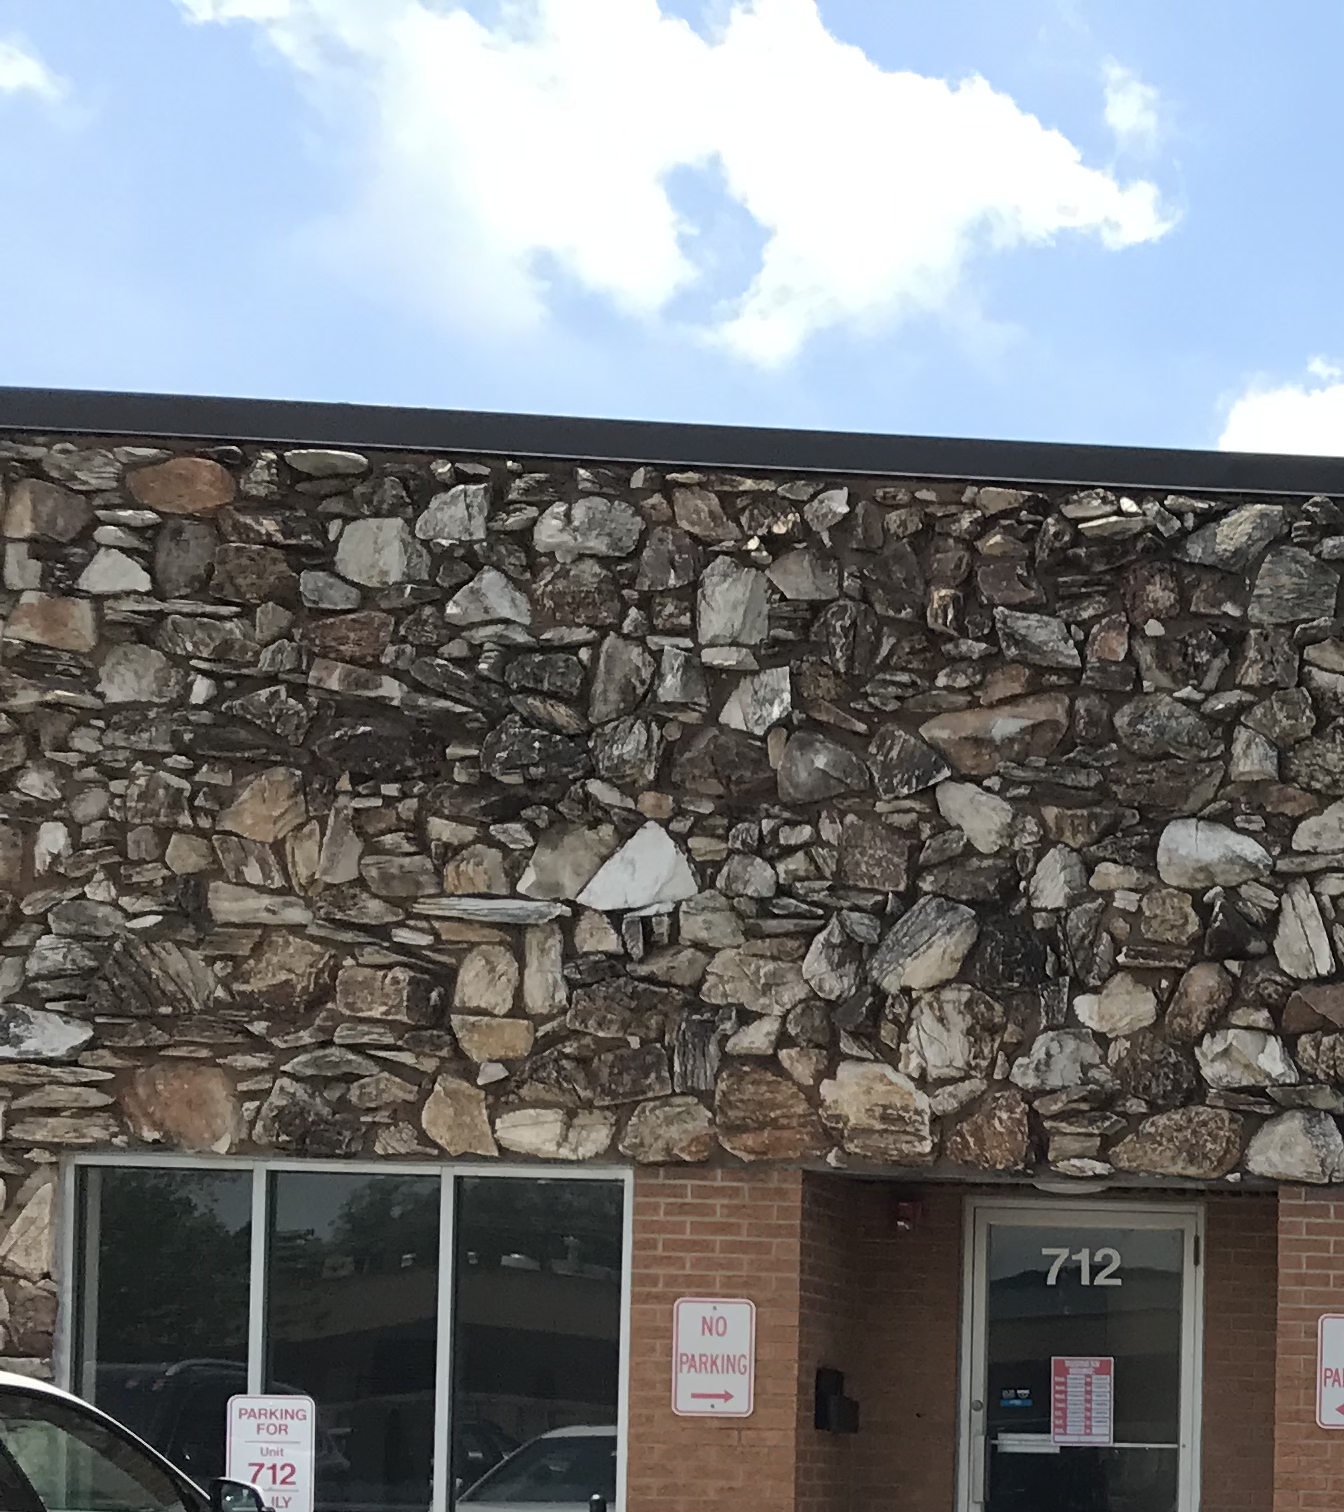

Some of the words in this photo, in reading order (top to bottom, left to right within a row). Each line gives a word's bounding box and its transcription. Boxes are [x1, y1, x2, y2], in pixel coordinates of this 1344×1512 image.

[1041, 1247, 1122, 1286] 712
[701, 1316, 728, 1337] NO
[679, 1353, 747, 1375] PARKING
[238, 1408, 307, 1421] PARKING
[256, 1423, 289, 1435] FOR
[260, 1447, 284, 1457] Unit
[248, 1463, 296, 1486] 712
